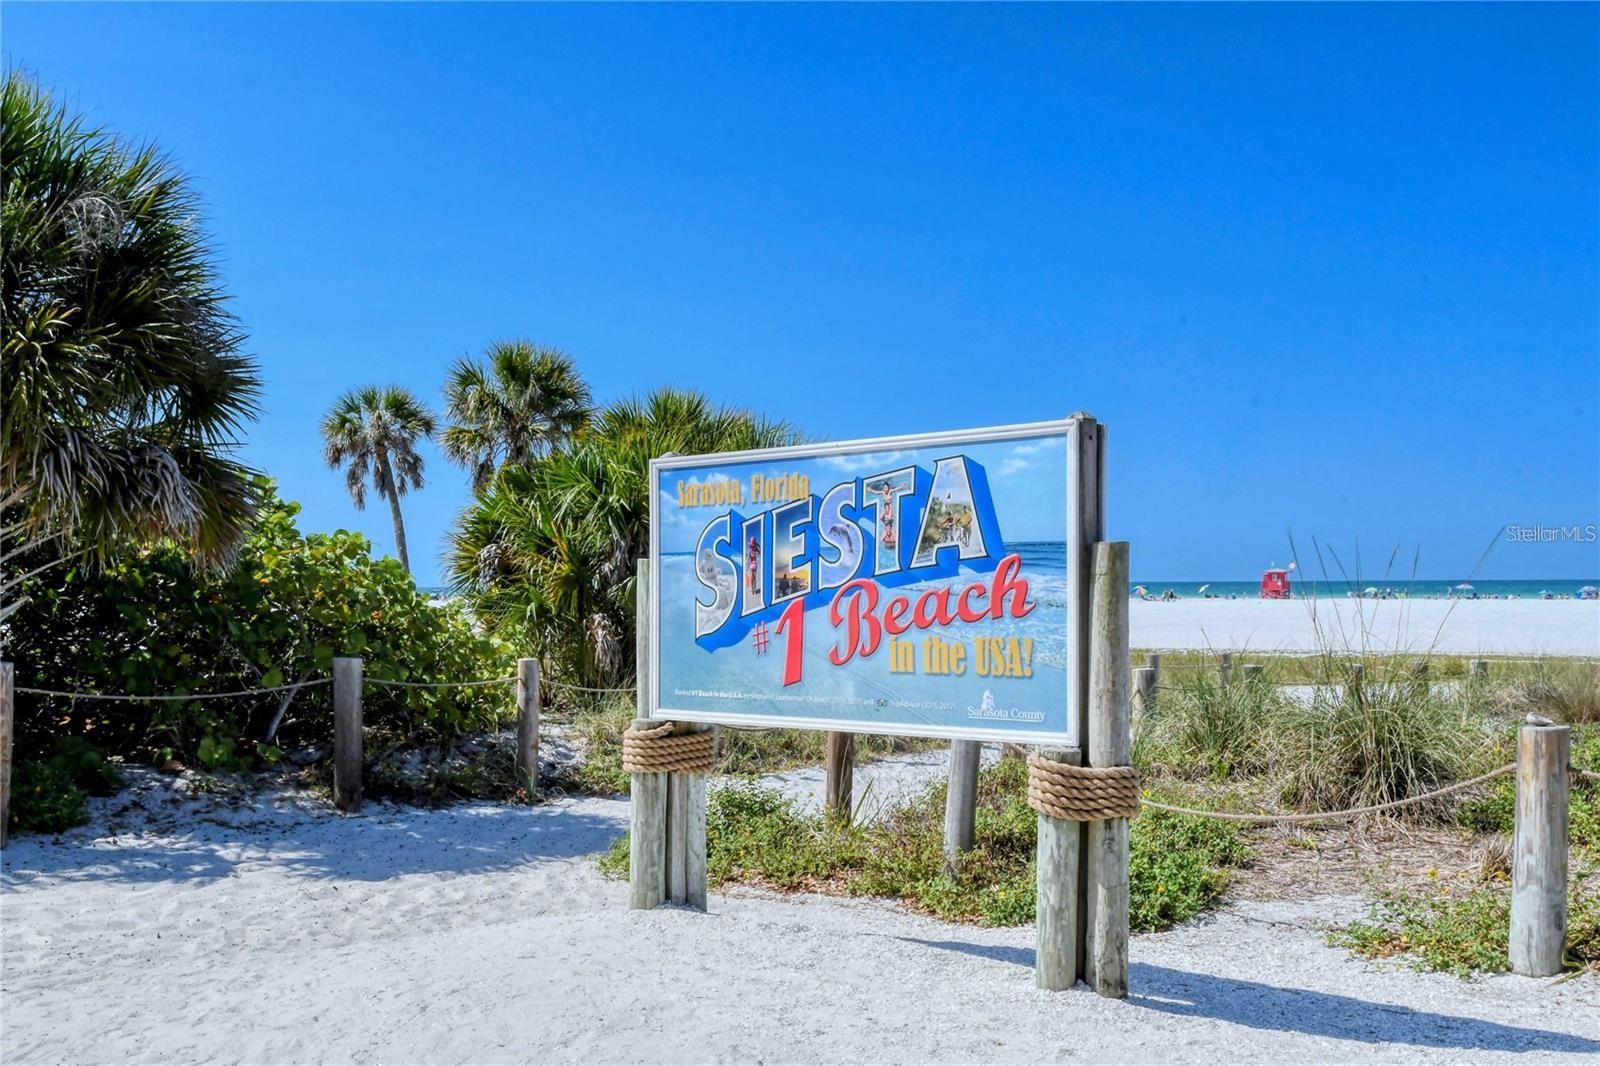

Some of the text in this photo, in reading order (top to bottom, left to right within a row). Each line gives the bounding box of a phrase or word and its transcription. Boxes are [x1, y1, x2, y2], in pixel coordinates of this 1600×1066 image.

[676, 473, 811, 508] Sarasota, Florida
[695, 455, 1002, 650] SIESTA
[753, 554, 1037, 687] #1 Beach
[889, 634, 1034, 678] in the USA!
[967, 706, 1009, 718] Sarasota
[1011, 707, 1046, 721] County
